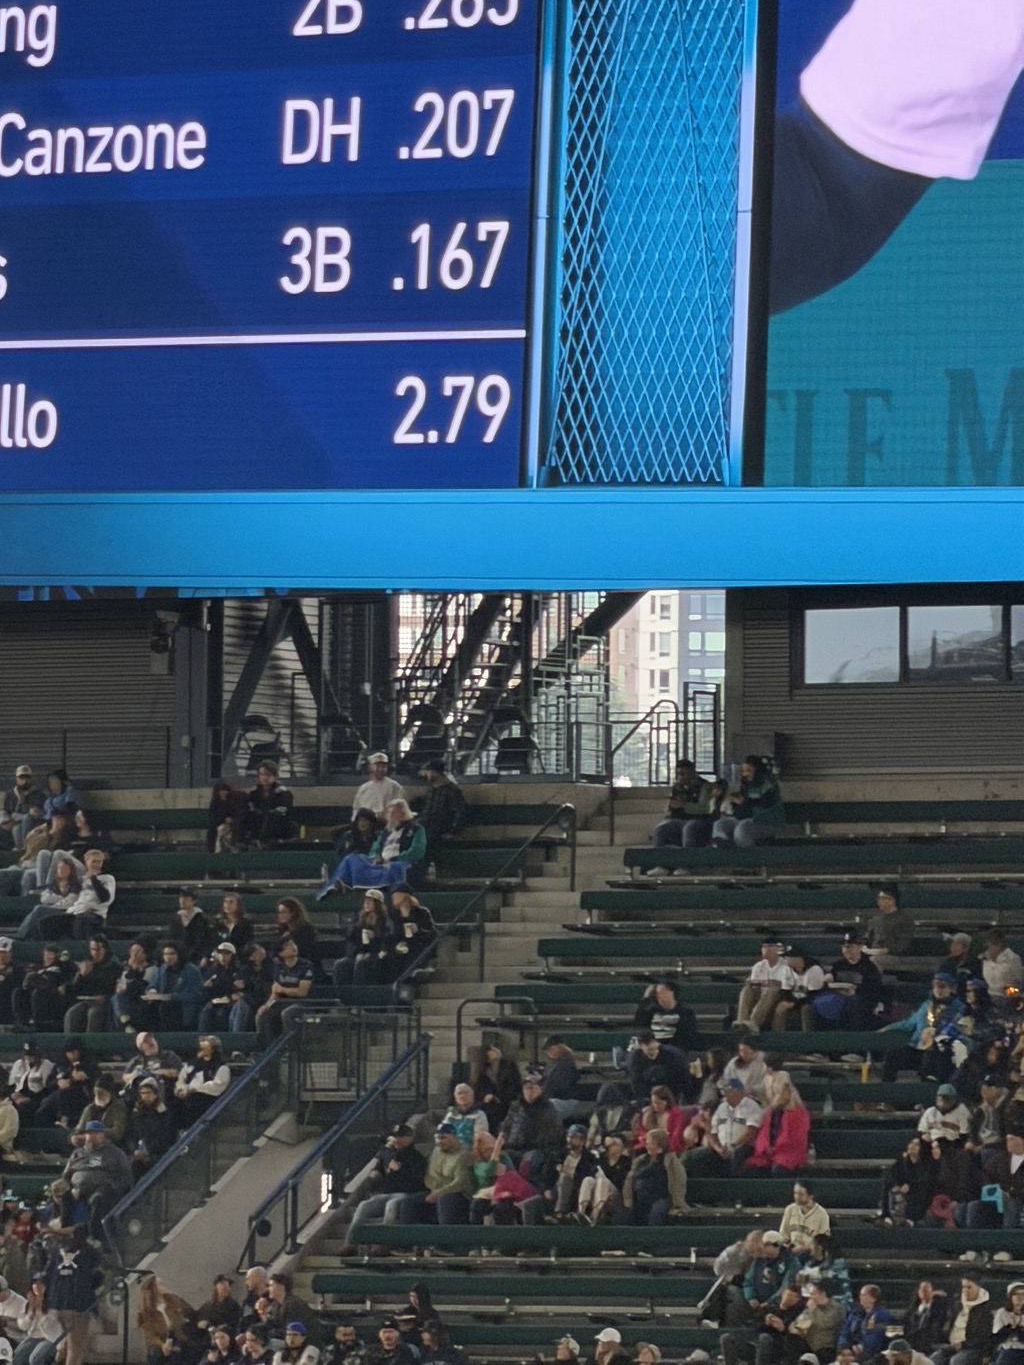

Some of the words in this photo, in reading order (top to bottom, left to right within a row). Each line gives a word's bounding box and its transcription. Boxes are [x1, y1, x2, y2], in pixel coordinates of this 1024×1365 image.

[281, 95, 362, 166] DH
[398, 88, 516, 161] .207
[279, 225, 352, 296] 3B
[392, 219, 511, 292] .167
[392, 373, 512, 445] 2.79
